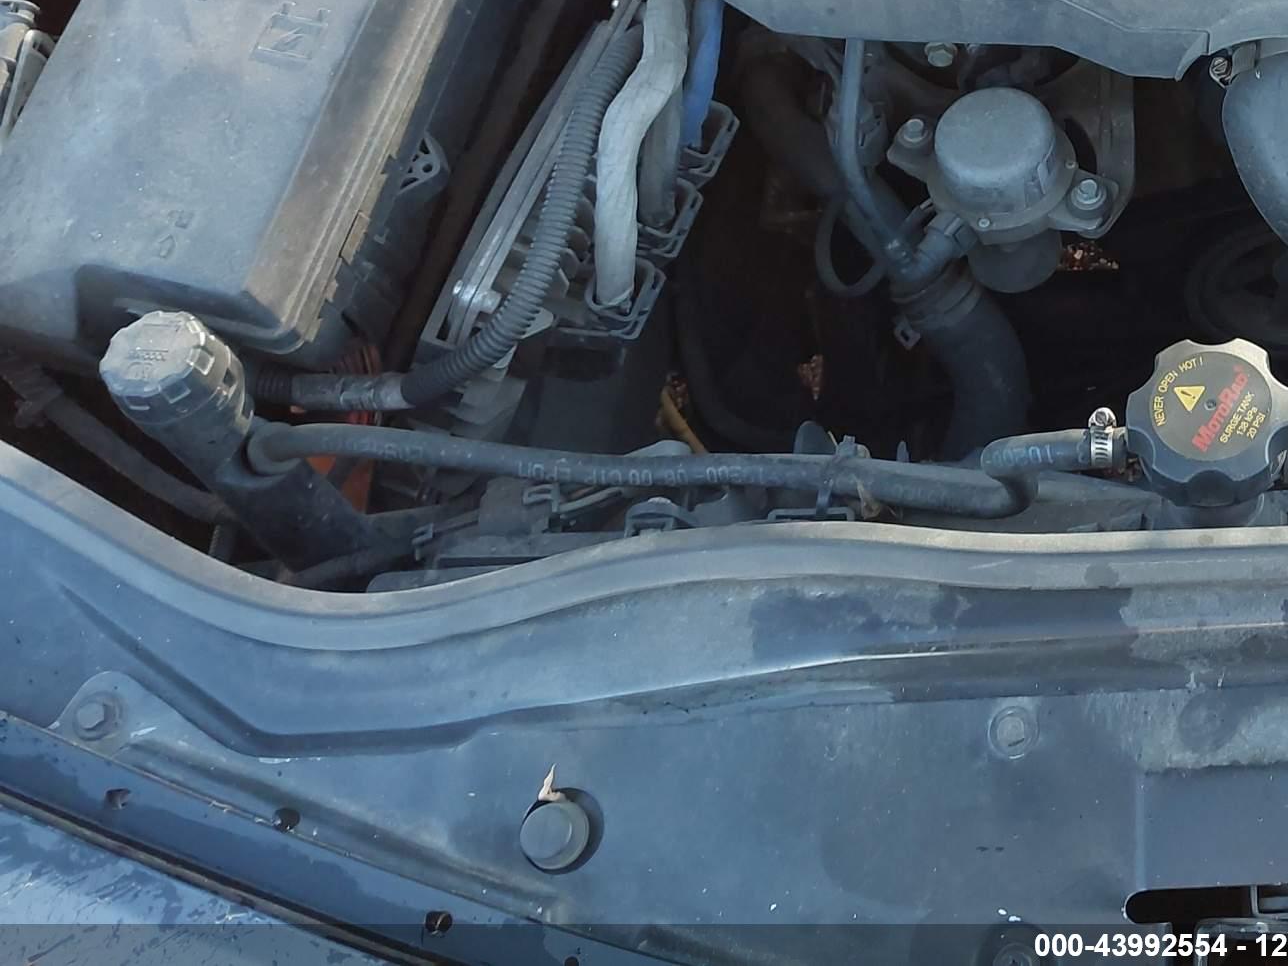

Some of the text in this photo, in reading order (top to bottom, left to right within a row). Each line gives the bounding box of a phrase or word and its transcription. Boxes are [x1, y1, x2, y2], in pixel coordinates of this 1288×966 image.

[1158, 369, 1178, 393] OPEN
[1153, 396, 1166, 426] NEVER
[1220, 392, 1255, 443] SURGE TANK
[1245, 407, 1258, 422] kPa
[1246, 412, 1266, 440] 20 PSI
